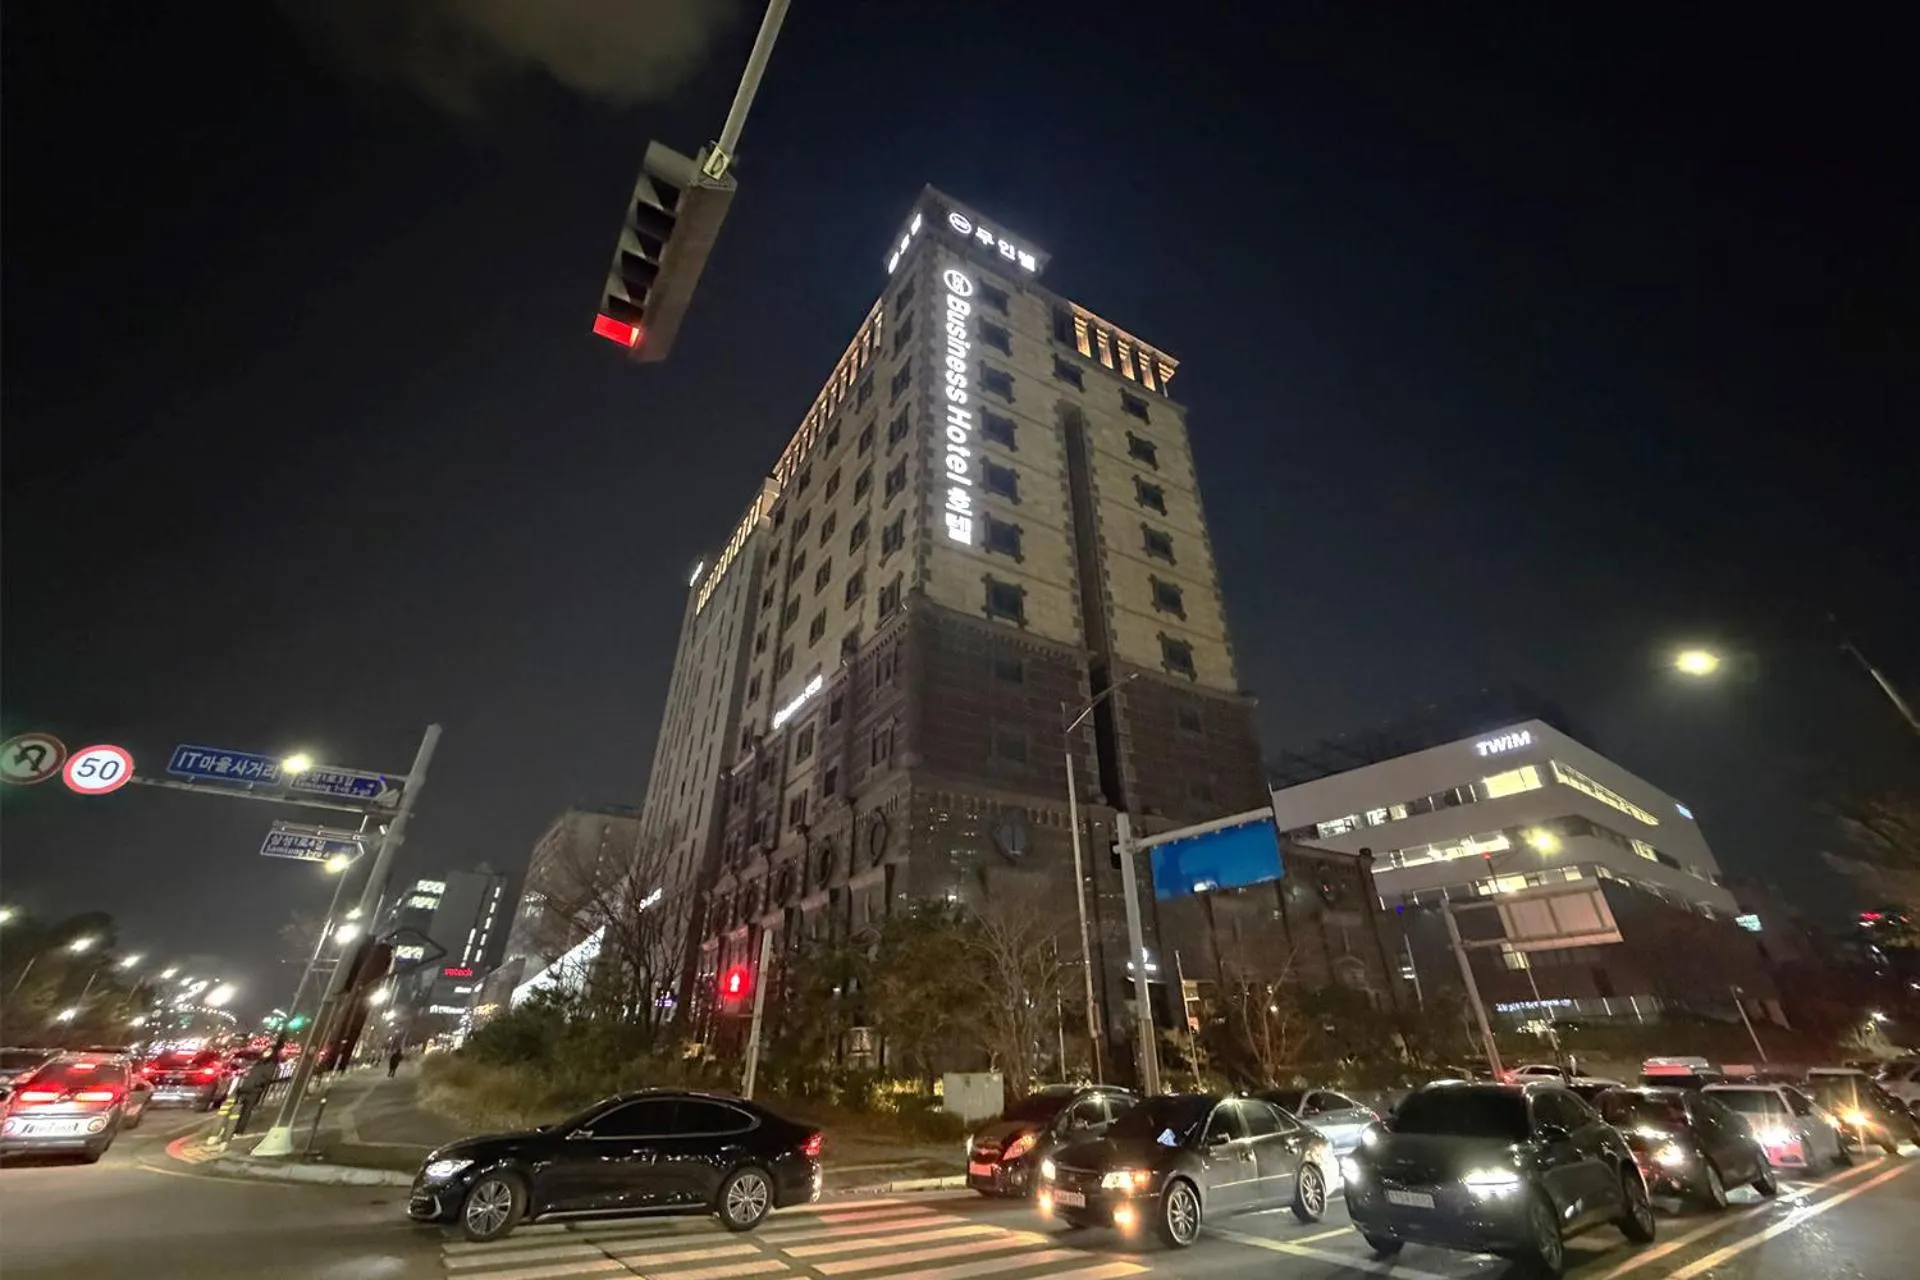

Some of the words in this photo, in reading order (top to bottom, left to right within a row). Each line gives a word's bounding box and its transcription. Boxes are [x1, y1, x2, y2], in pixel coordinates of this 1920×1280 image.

[945, 294, 971, 404] Business
[945, 404, 973, 486] Hotel
[77, 757, 120, 780] 50
[177, 751, 279, 779] IT마을사거리
